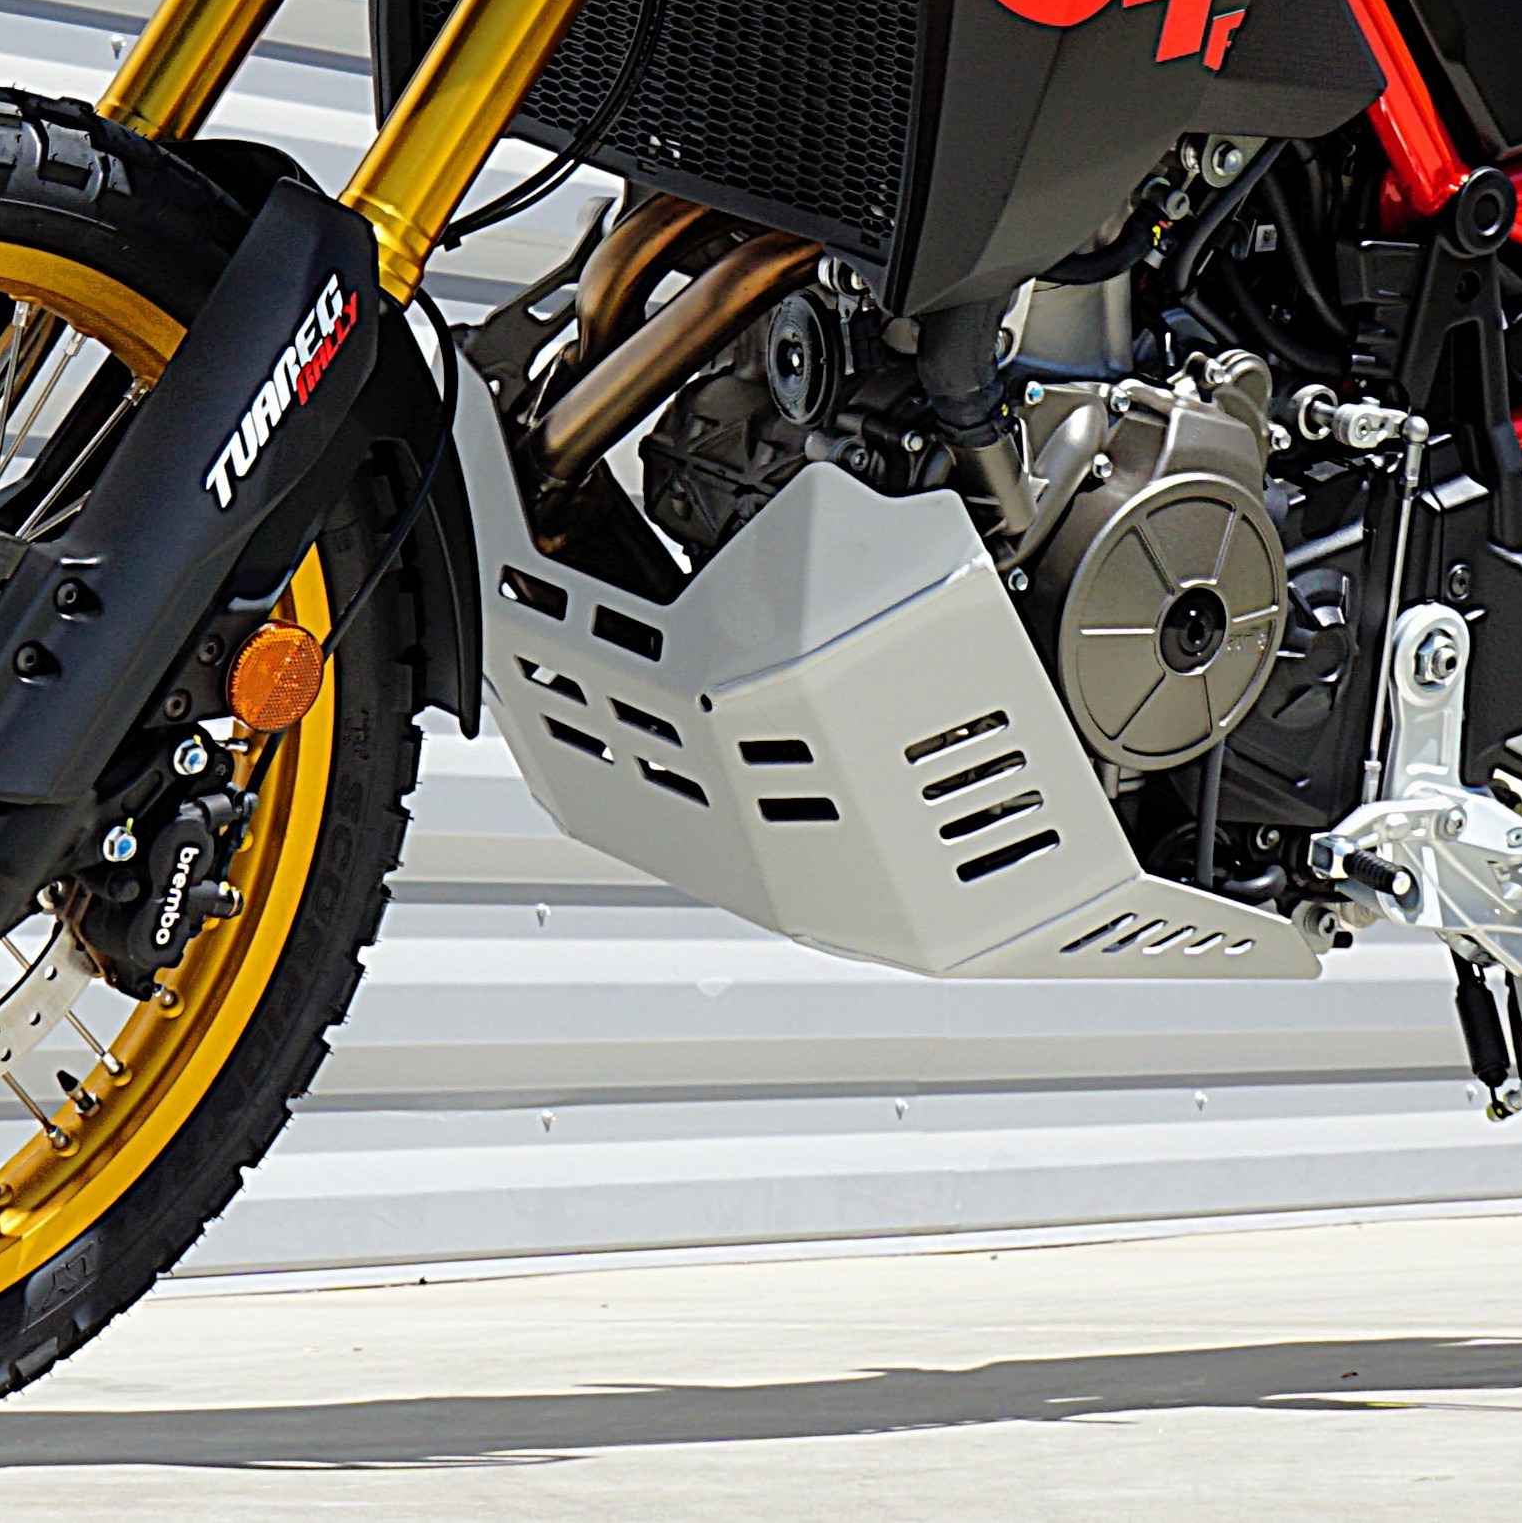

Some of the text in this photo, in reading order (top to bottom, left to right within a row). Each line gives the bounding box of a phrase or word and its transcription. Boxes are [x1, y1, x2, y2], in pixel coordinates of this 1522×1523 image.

[205, 273, 344, 509] TUAREG
[295, 291, 358, 406] RALLY
[155, 846, 200, 946] brembo
